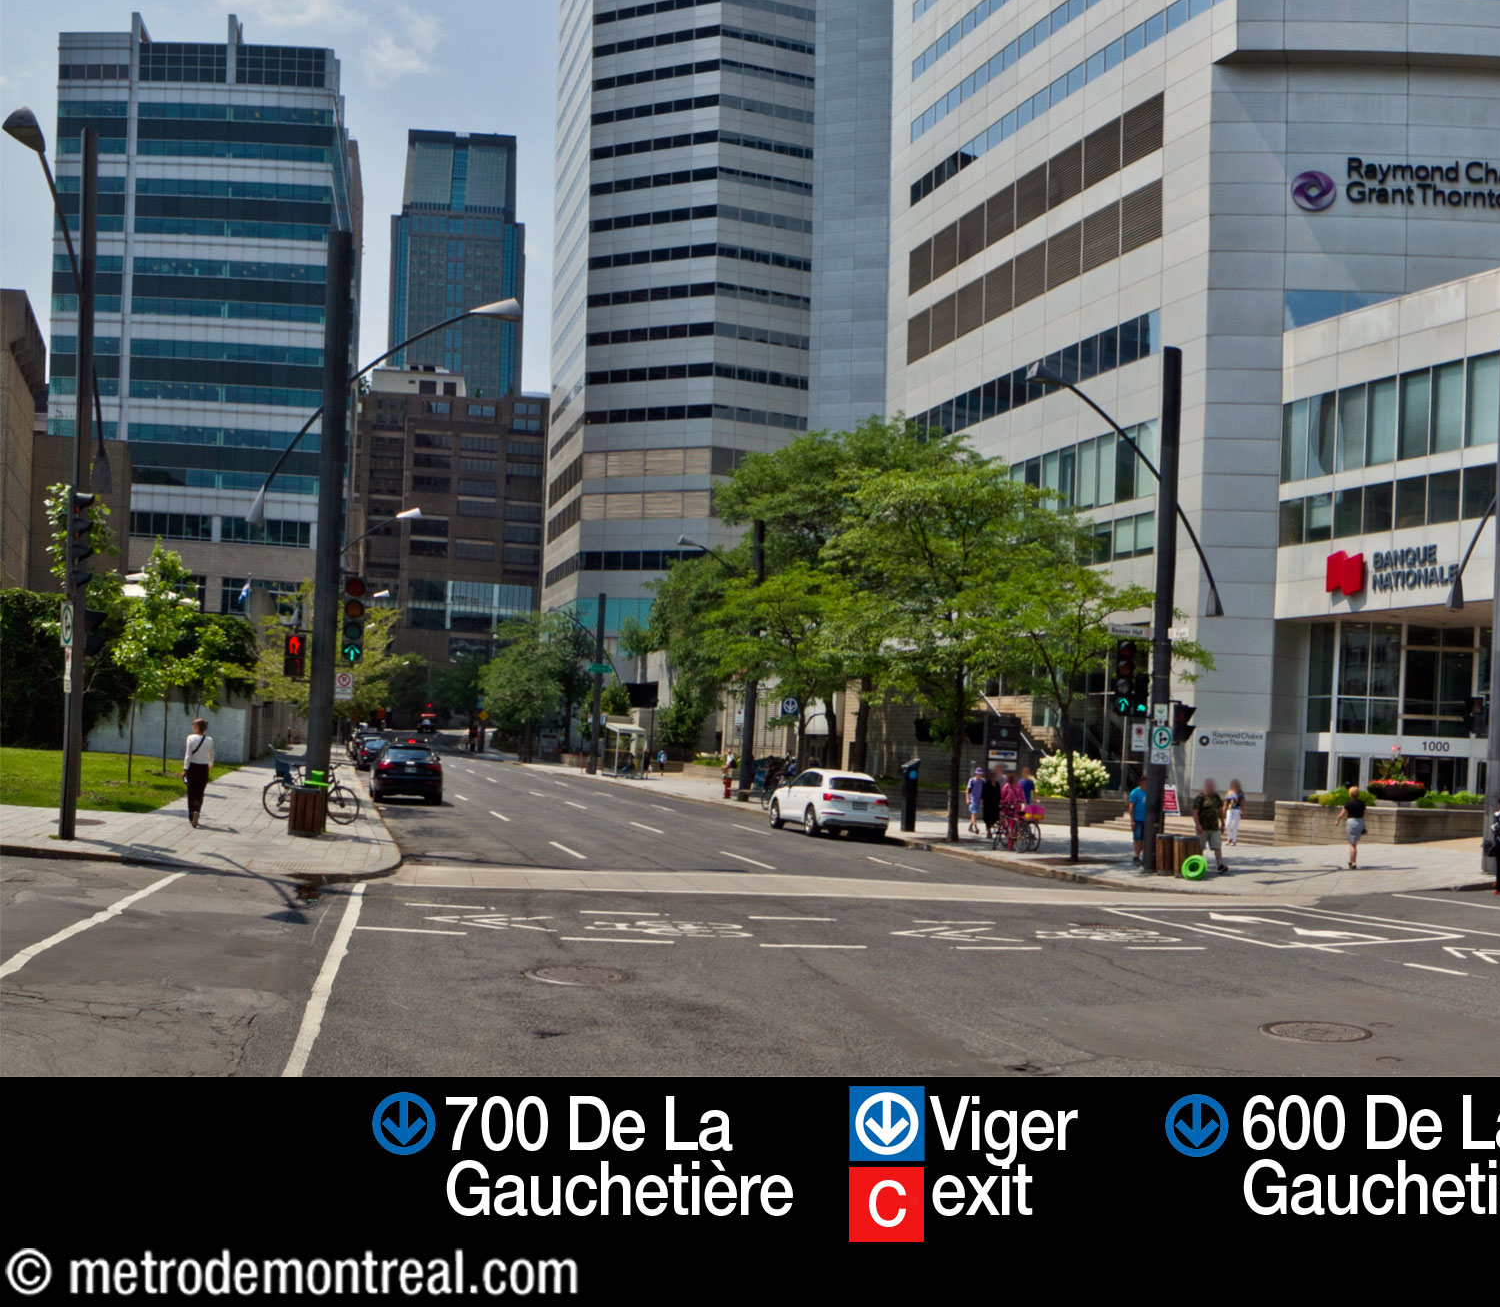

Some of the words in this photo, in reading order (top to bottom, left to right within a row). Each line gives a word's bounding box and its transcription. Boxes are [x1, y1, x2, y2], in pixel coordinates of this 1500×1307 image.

[1347, 157, 1459, 183] Raymond
[1346, 181, 1414, 204] Grant
[1373, 544, 1438, 570] BANQUE
[1372, 564, 1460, 592] NATIONALE
[1422, 741, 1450, 752] 1000
